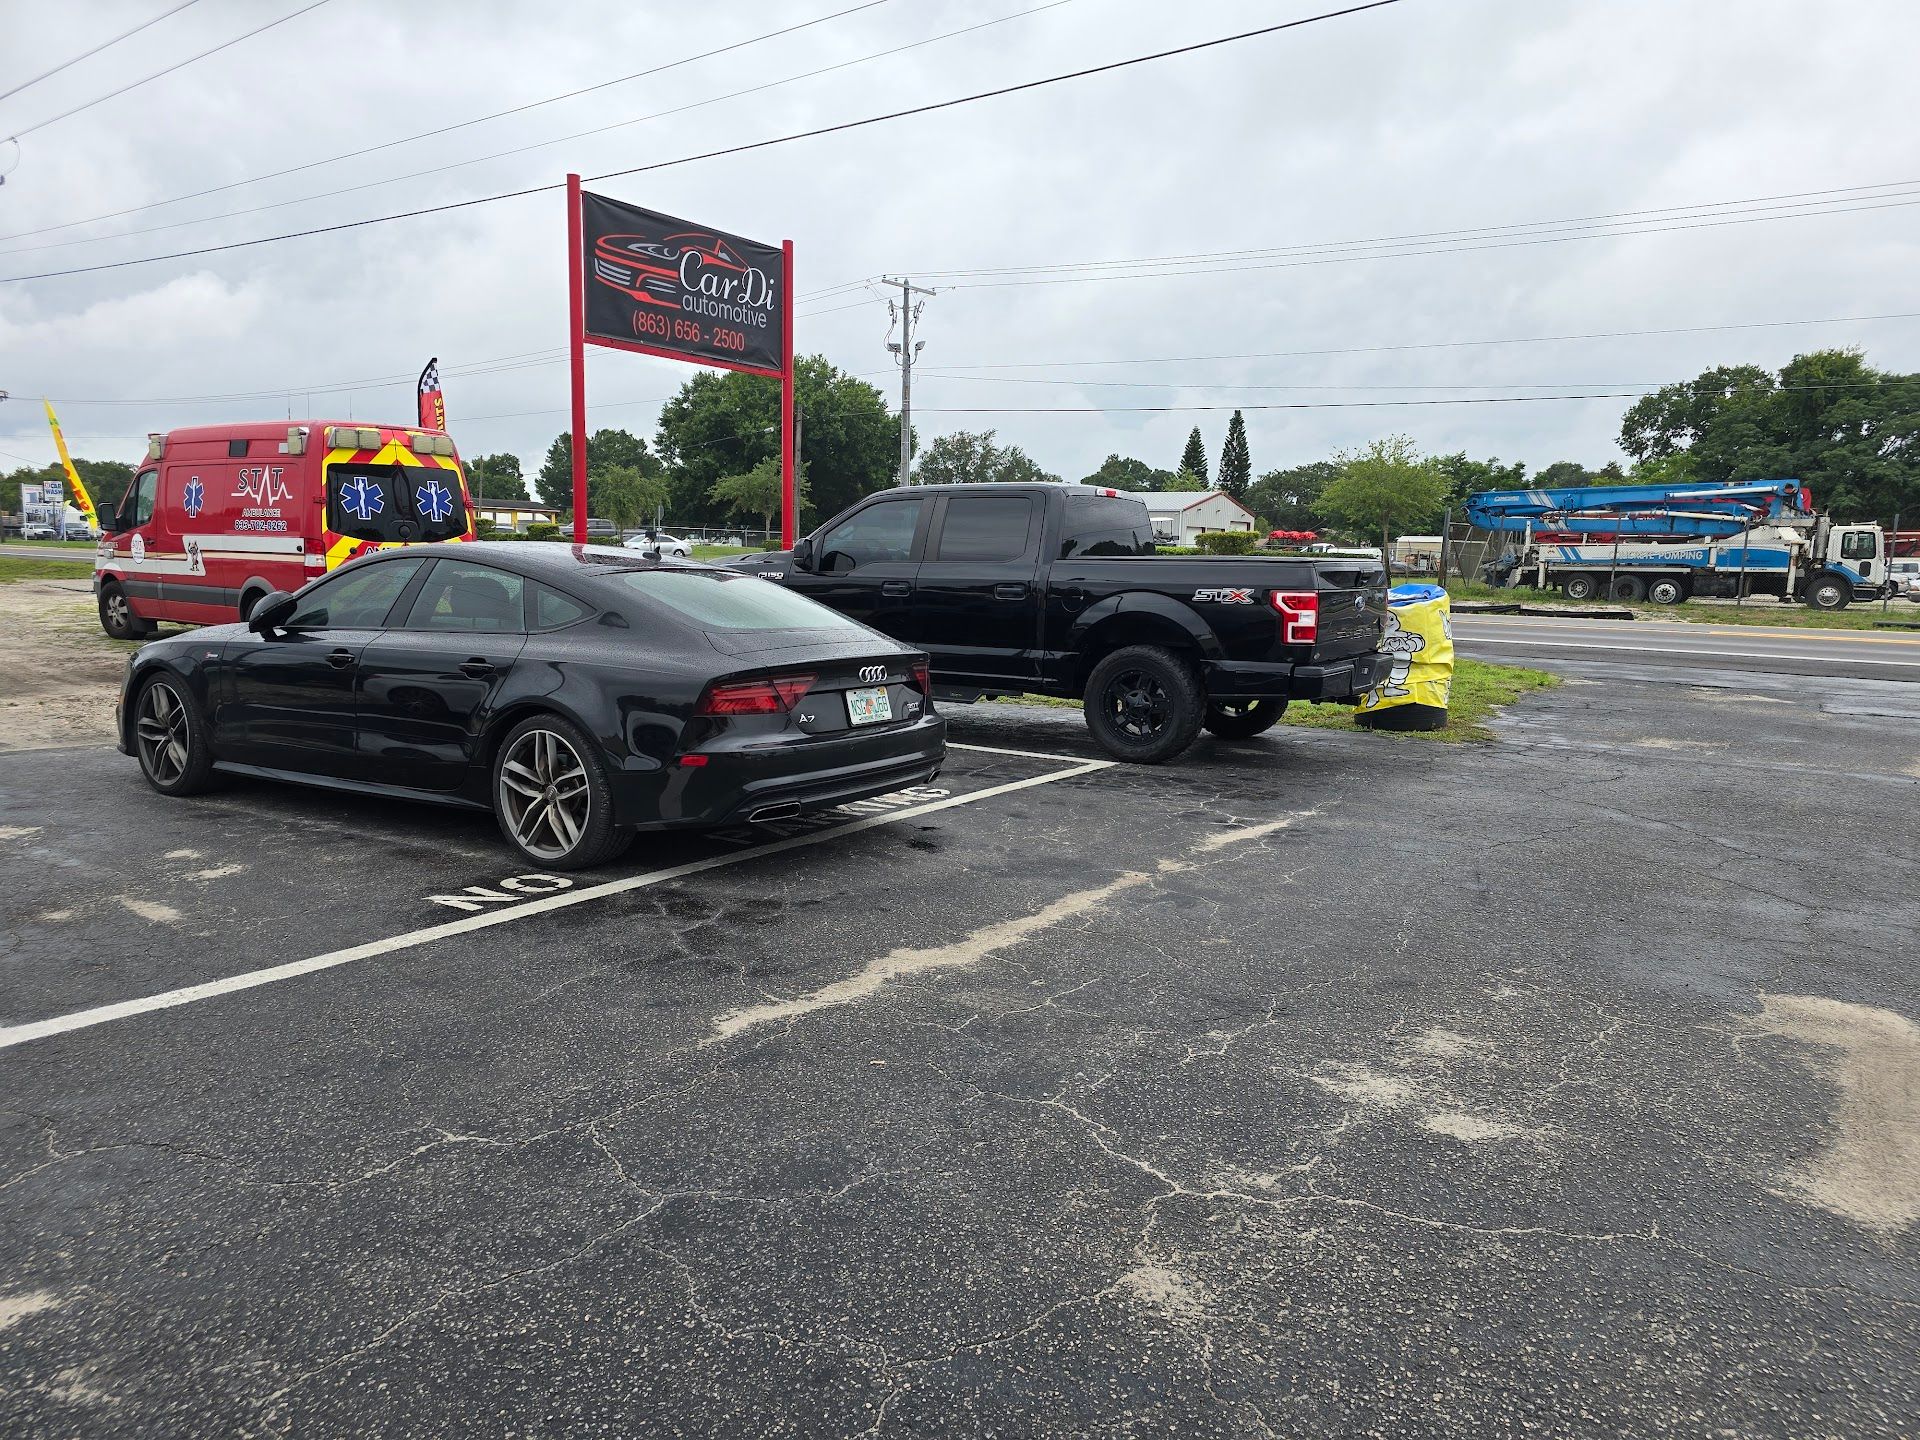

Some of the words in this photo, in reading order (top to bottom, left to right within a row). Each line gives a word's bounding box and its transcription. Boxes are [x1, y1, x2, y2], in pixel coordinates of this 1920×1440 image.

[682, 294, 767, 328] automotive
[632, 309, 671, 341] (863)
[674, 319, 700, 342] 656
[713, 327, 744, 351] 2500
[238, 465, 284, 495] STAT
[242, 508, 281, 517] AMBULANCE
[1192, 588, 1254, 605] STX
[799, 713, 815, 723] A7
[421, 873, 573, 911] NO
